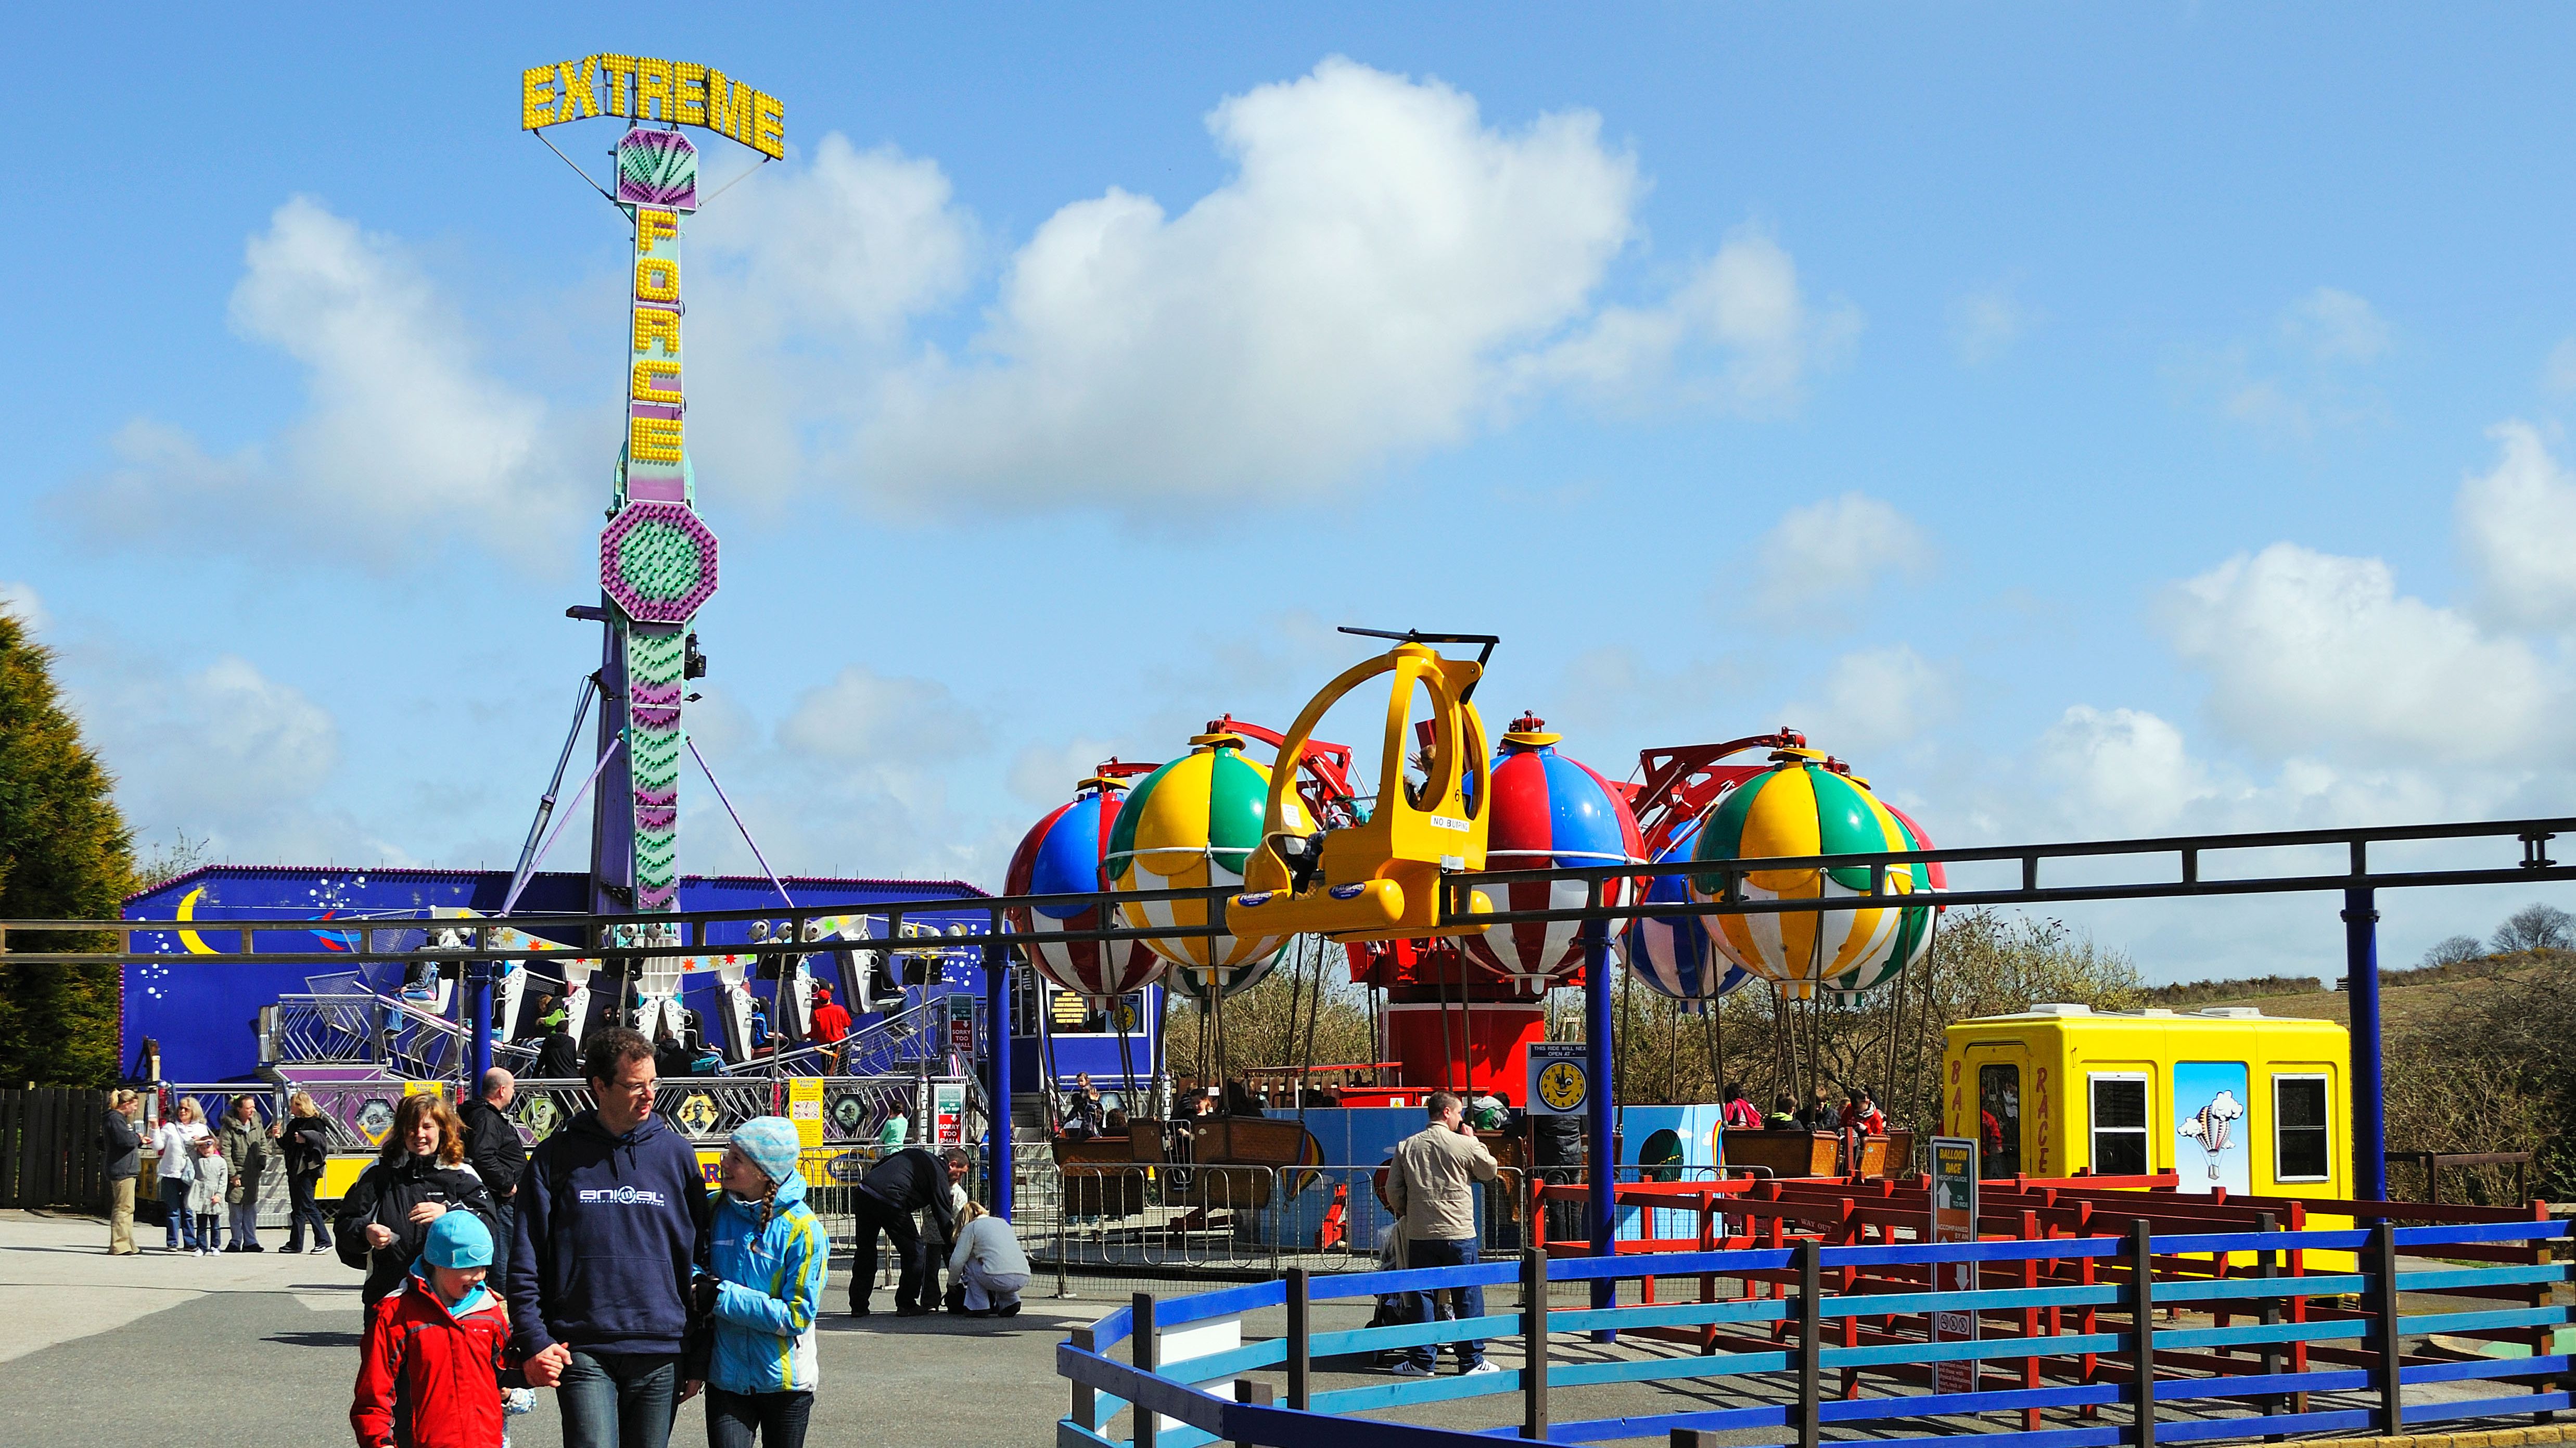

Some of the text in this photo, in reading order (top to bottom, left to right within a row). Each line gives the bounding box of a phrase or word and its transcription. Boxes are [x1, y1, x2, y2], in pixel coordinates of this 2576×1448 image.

[522, 52, 784, 160] EXTREME
[631, 209, 683, 462] FORCE
[1455, 789, 1460, 802] 6
[1434, 817, 1444, 825] NO
[2036, 1068, 2049, 1173] RACE
[1940, 1149, 1968, 1160] BALLOON
[1945, 1162, 1962, 1174] RACE
[1801, 1218, 1832, 1232] WAY OUT
[1937, 1224, 1969, 1233] ACCOMPANIED
